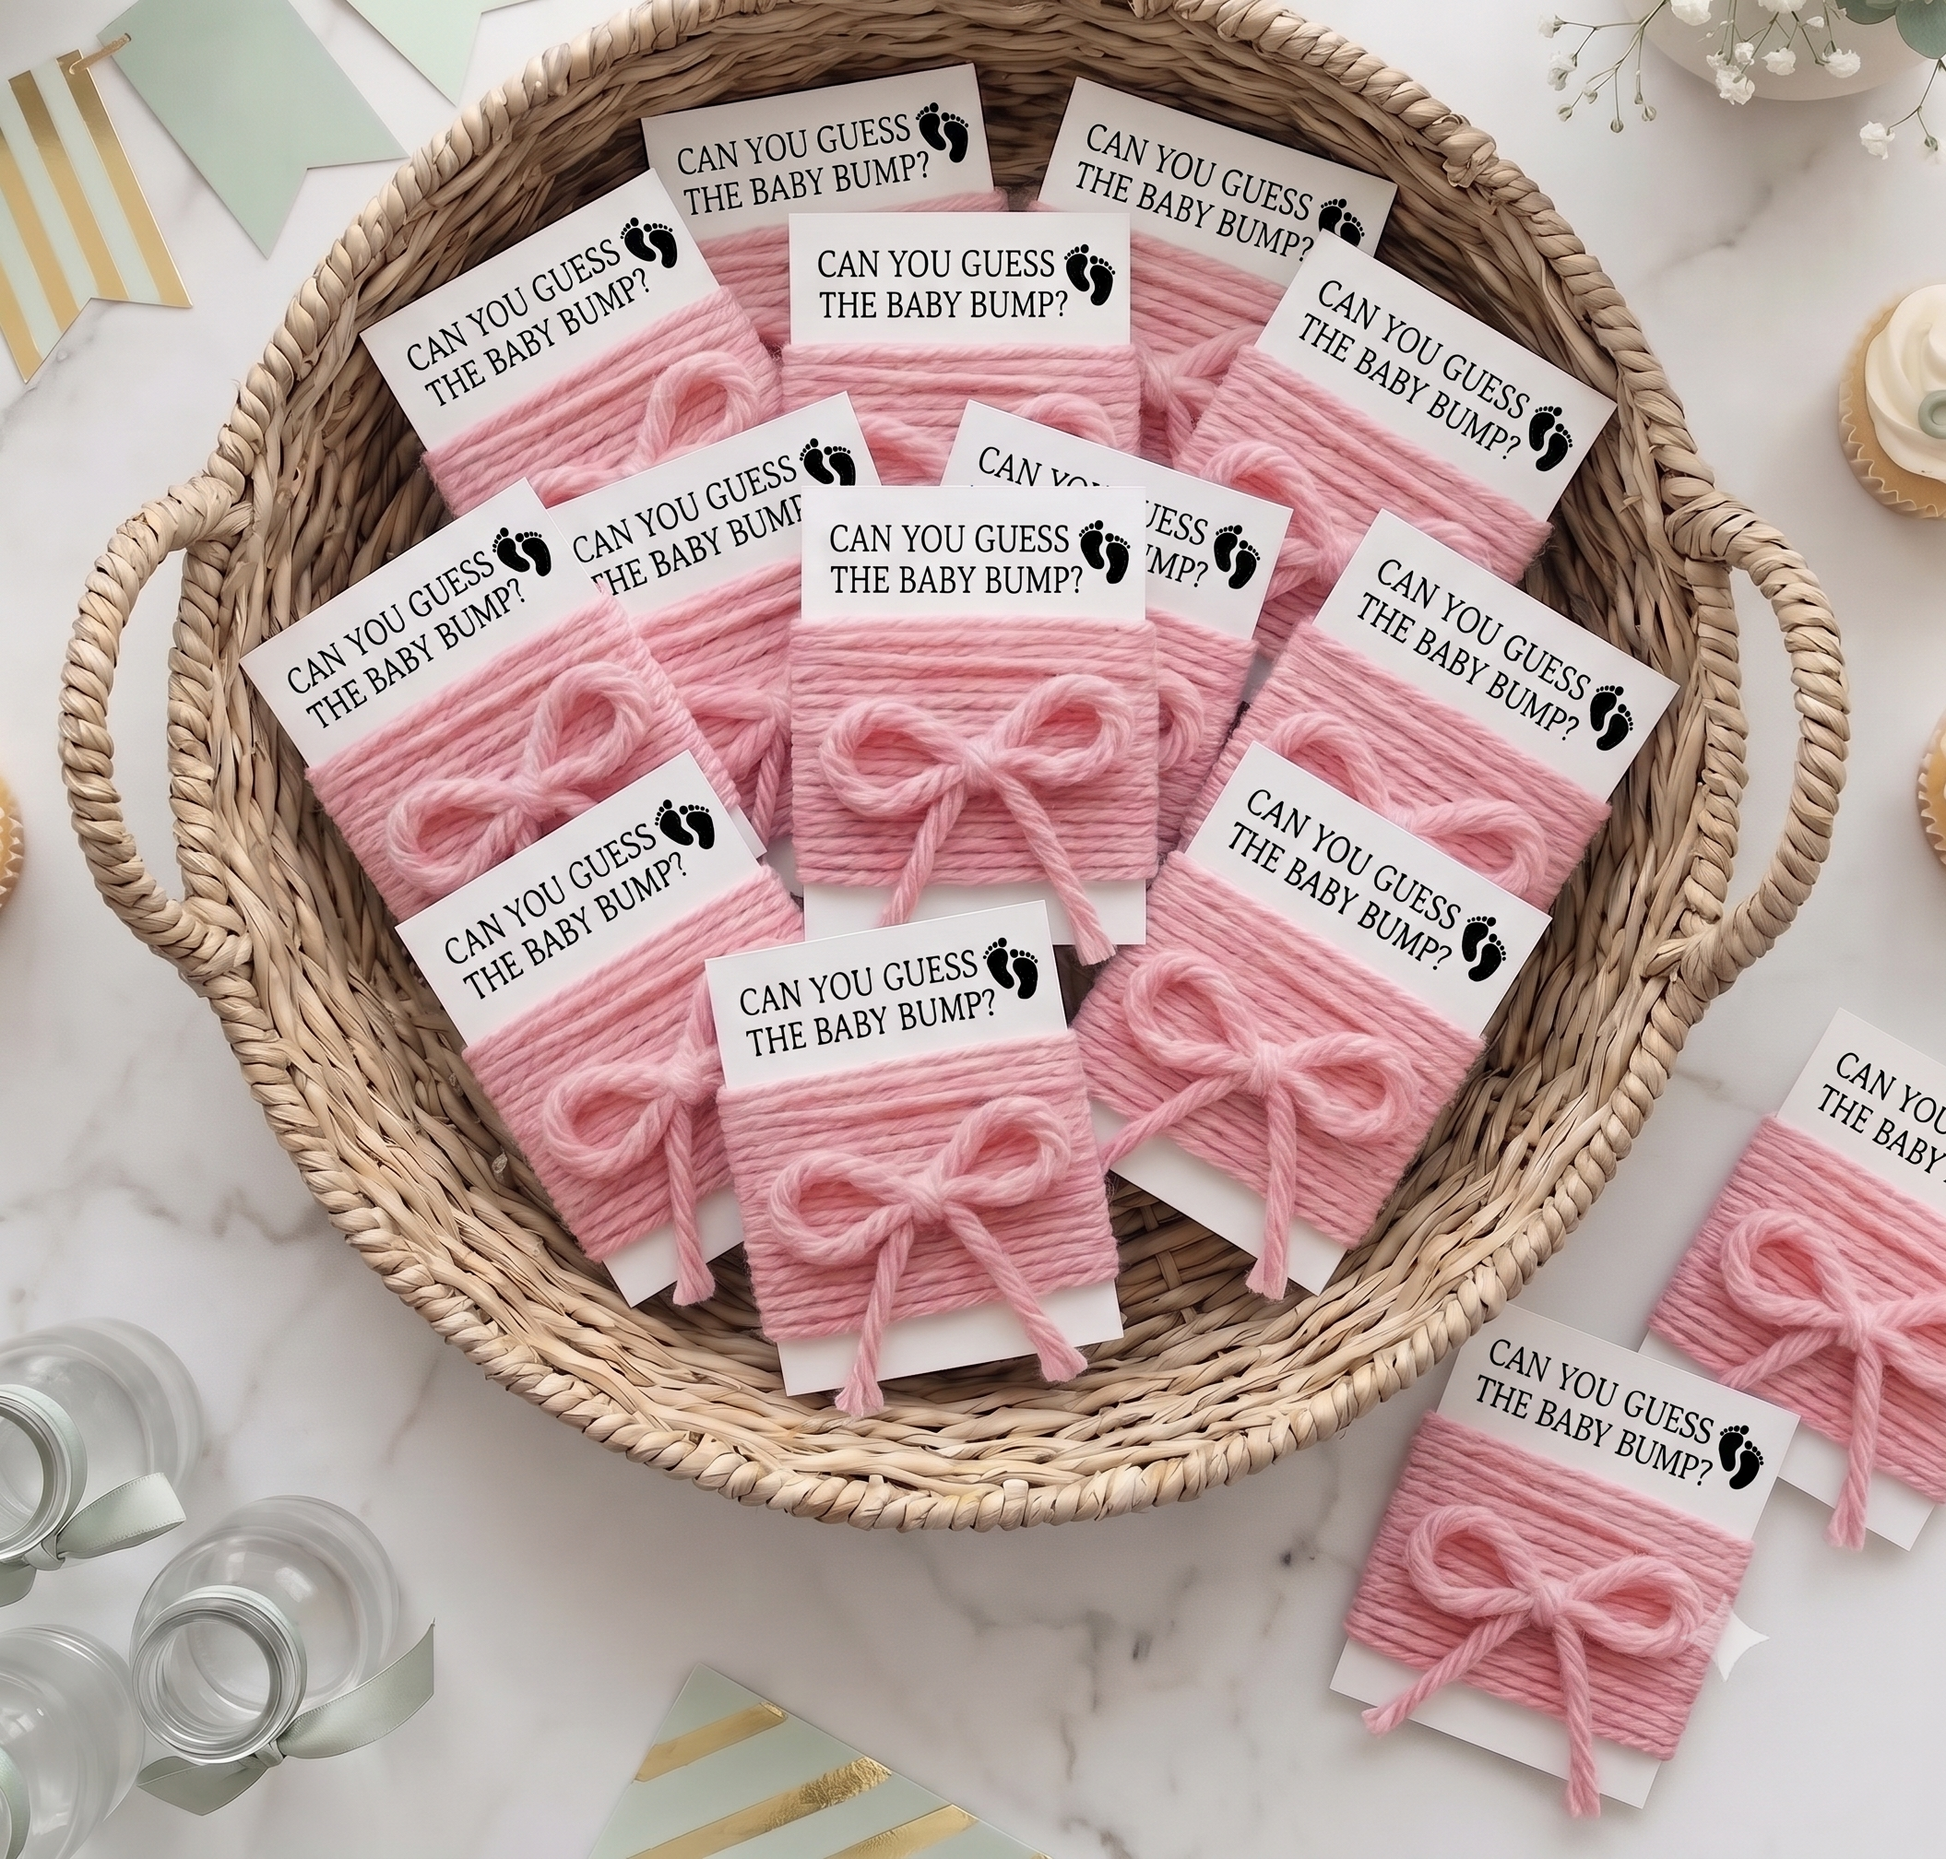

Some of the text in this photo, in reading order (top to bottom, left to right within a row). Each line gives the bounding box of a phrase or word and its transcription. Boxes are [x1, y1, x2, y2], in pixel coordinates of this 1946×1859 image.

[677, 113, 911, 176] CAN YOU GUESS
[682, 150, 930, 216] THE BABY BUMP?
[1086, 123, 1314, 221] CAN YOU GUESS
[817, 249, 1055, 278] CAN YOU GUESS
[1075, 160, 1315, 263] THE BABY BUMP?
[406, 238, 621, 371] CAN YOU GUESS
[424, 267, 650, 407] THE BABY BUMP?
[819, 290, 1069, 319] THE BABY BUMP?
[1318, 279, 1531, 420] CAN YOU GUESS
[1298, 312, 1522, 460] THE BABY BUMP?
[572, 454, 797, 564] CAN YOU GUESS
[648, 525, 722, 579] BABY
[725, 493, 802, 548] BUMP
[829, 524, 1071, 554] CAN YOU GUESS
[978, 446, 1043, 487] CAN
[1145, 499, 1210, 547] ESS
[830, 565, 1083, 595] THE BABY BUMP?
[1145, 543, 1210, 589] MP?
[287, 550, 495, 694] CAN YOU GUESS
[305, 577, 526, 729] THE BABY BUMP?
[1357, 591, 1580, 741] THE BABY BUMP?
[1377, 559, 1592, 701] CAN YOU GUESS
[444, 822, 657, 965] CAN YOU GUESS
[1228, 821, 1453, 971] THE BABY BUMP?
[1247, 789, 1462, 930] CAN YOU GUESS
[462, 851, 687, 1000] THE BABY BUMP?
[739, 949, 978, 1016] CAN YOU GUESS
[745, 988, 995, 1057] THE BABY BUMP?
[1817, 1083, 1946, 1174] THE BABY
[1836, 1052, 1897, 1101] CAN
[1475, 1373, 1714, 1487] THE BABY BUMP?
[1489, 1338, 1715, 1445] CAN YOU GUESS
